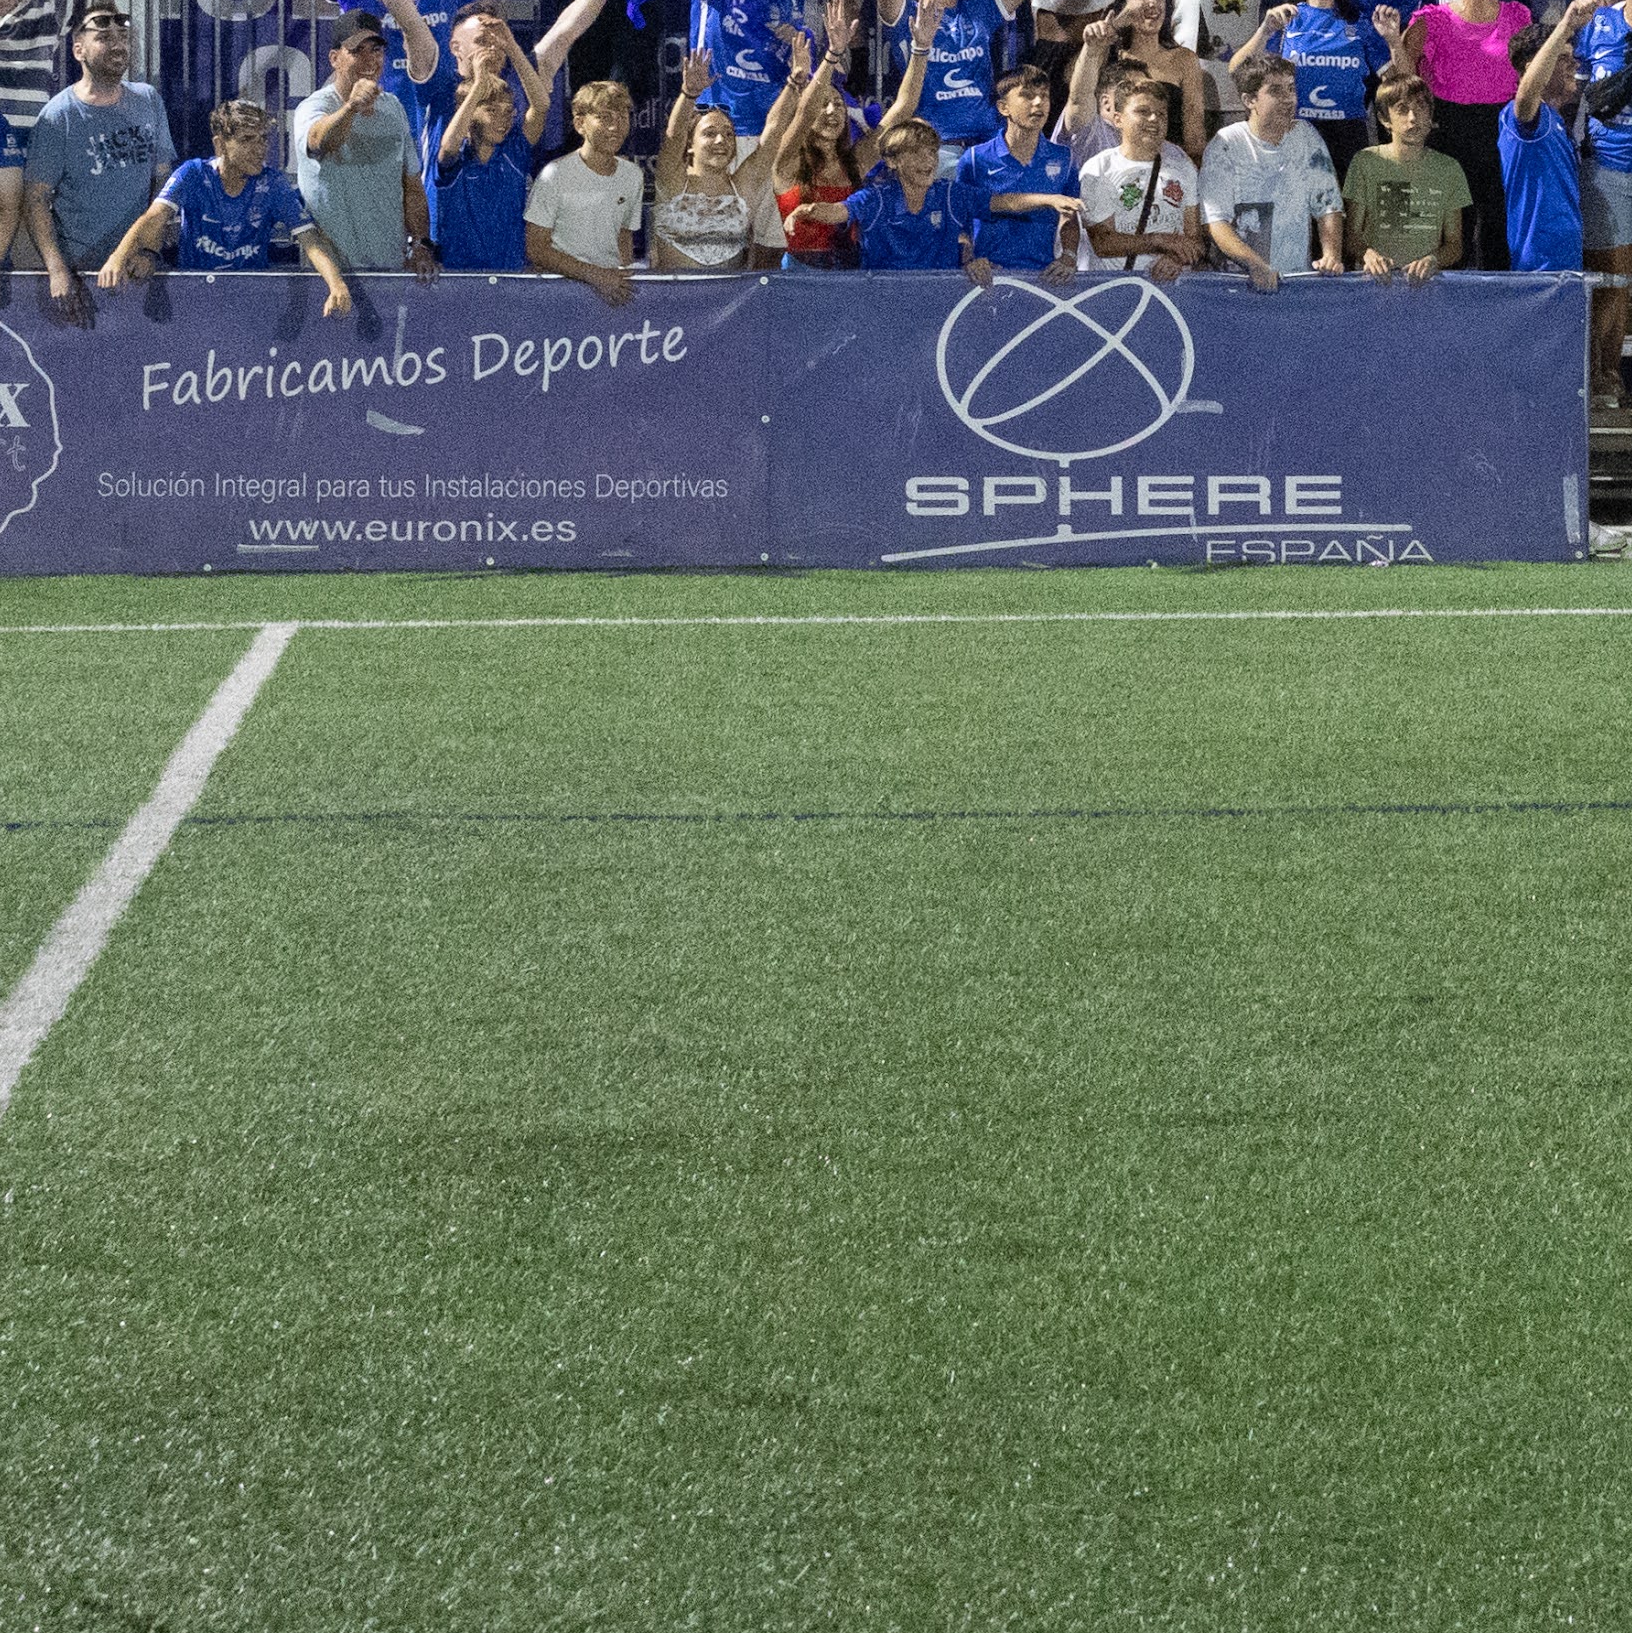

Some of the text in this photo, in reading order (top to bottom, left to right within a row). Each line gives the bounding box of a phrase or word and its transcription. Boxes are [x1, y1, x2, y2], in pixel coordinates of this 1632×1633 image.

[1290, 50, 1361, 70] Alcampo
[139, 317, 690, 411] Fabricamos Deporte
[96, 469, 729, 505] Solución Integral para tus Instalaciones Deportivas
[904, 475, 1344, 516] SPHERE
[249, 512, 578, 544] www.euronix.es
[1206, 532, 1435, 563] ESPAÑA
